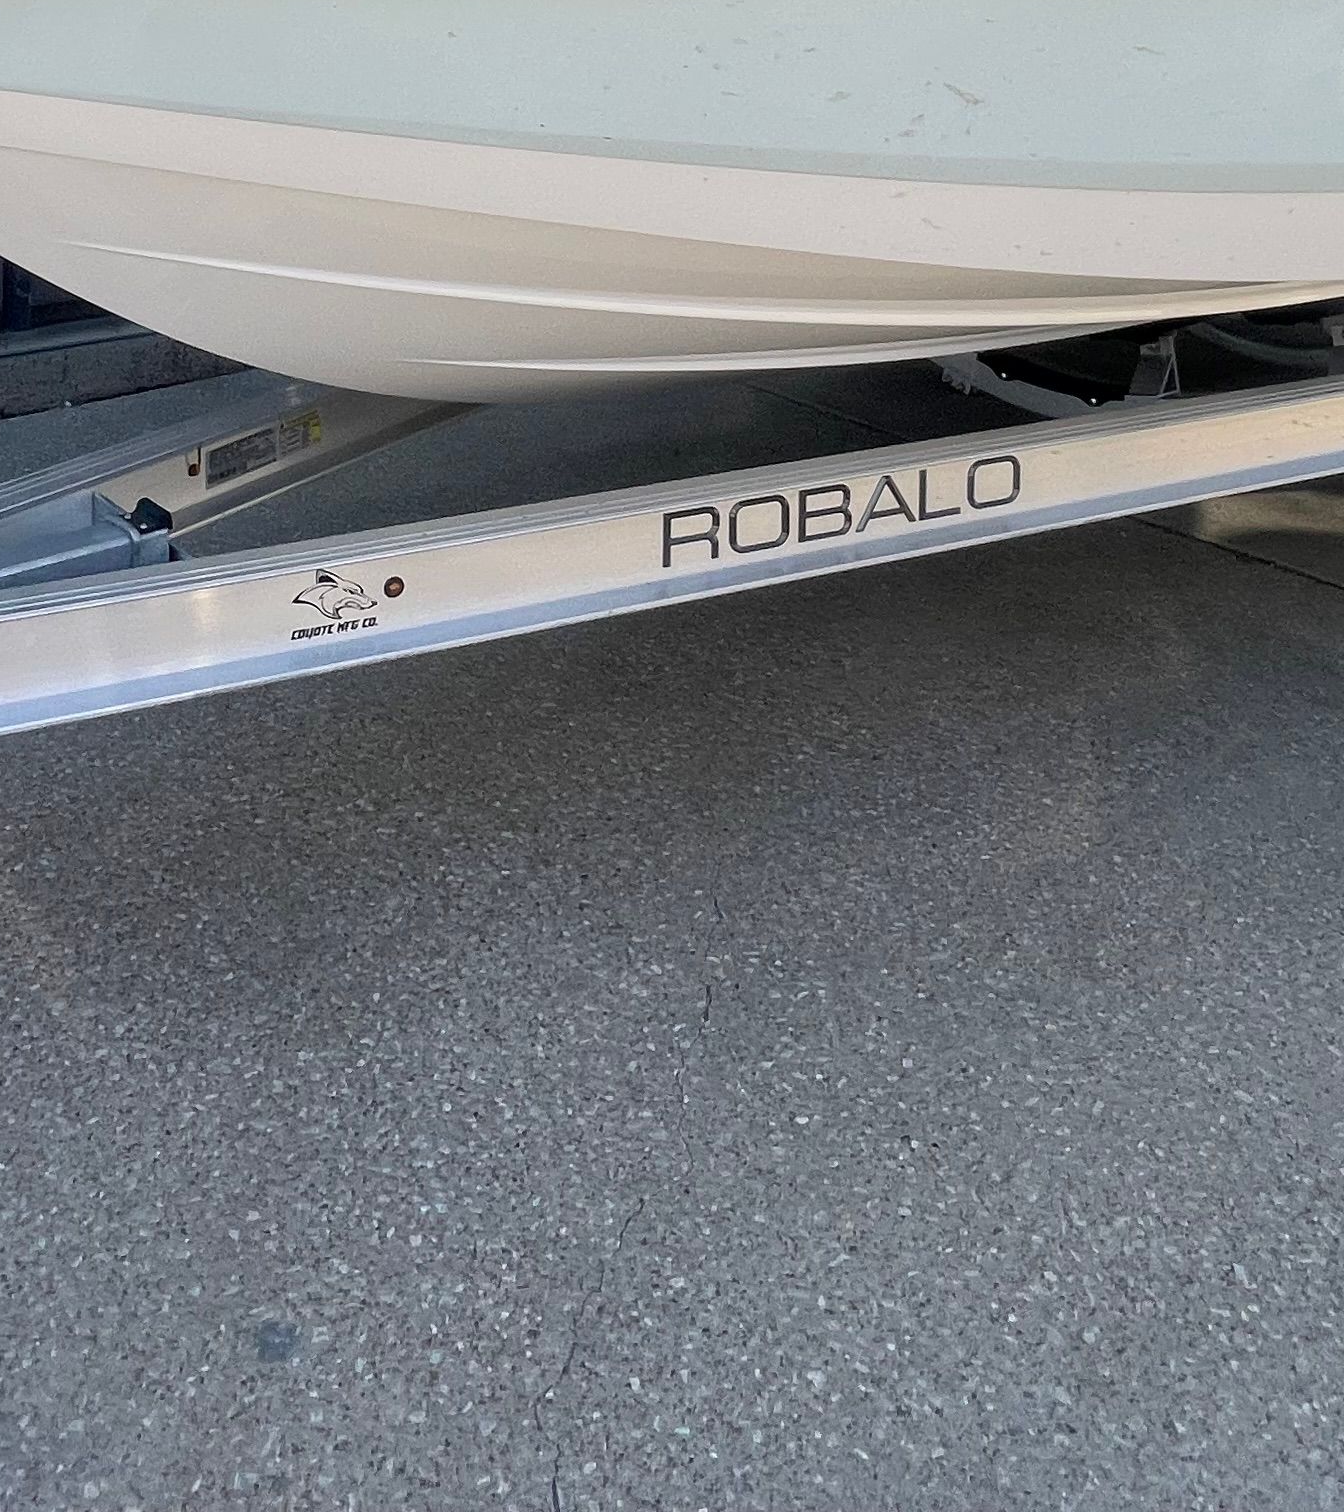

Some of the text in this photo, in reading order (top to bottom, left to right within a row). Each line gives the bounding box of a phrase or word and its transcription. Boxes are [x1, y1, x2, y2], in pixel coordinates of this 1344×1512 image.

[662, 455, 1021, 567] ROBALO
[290, 617, 378, 640] COYOTE MFG CO.
